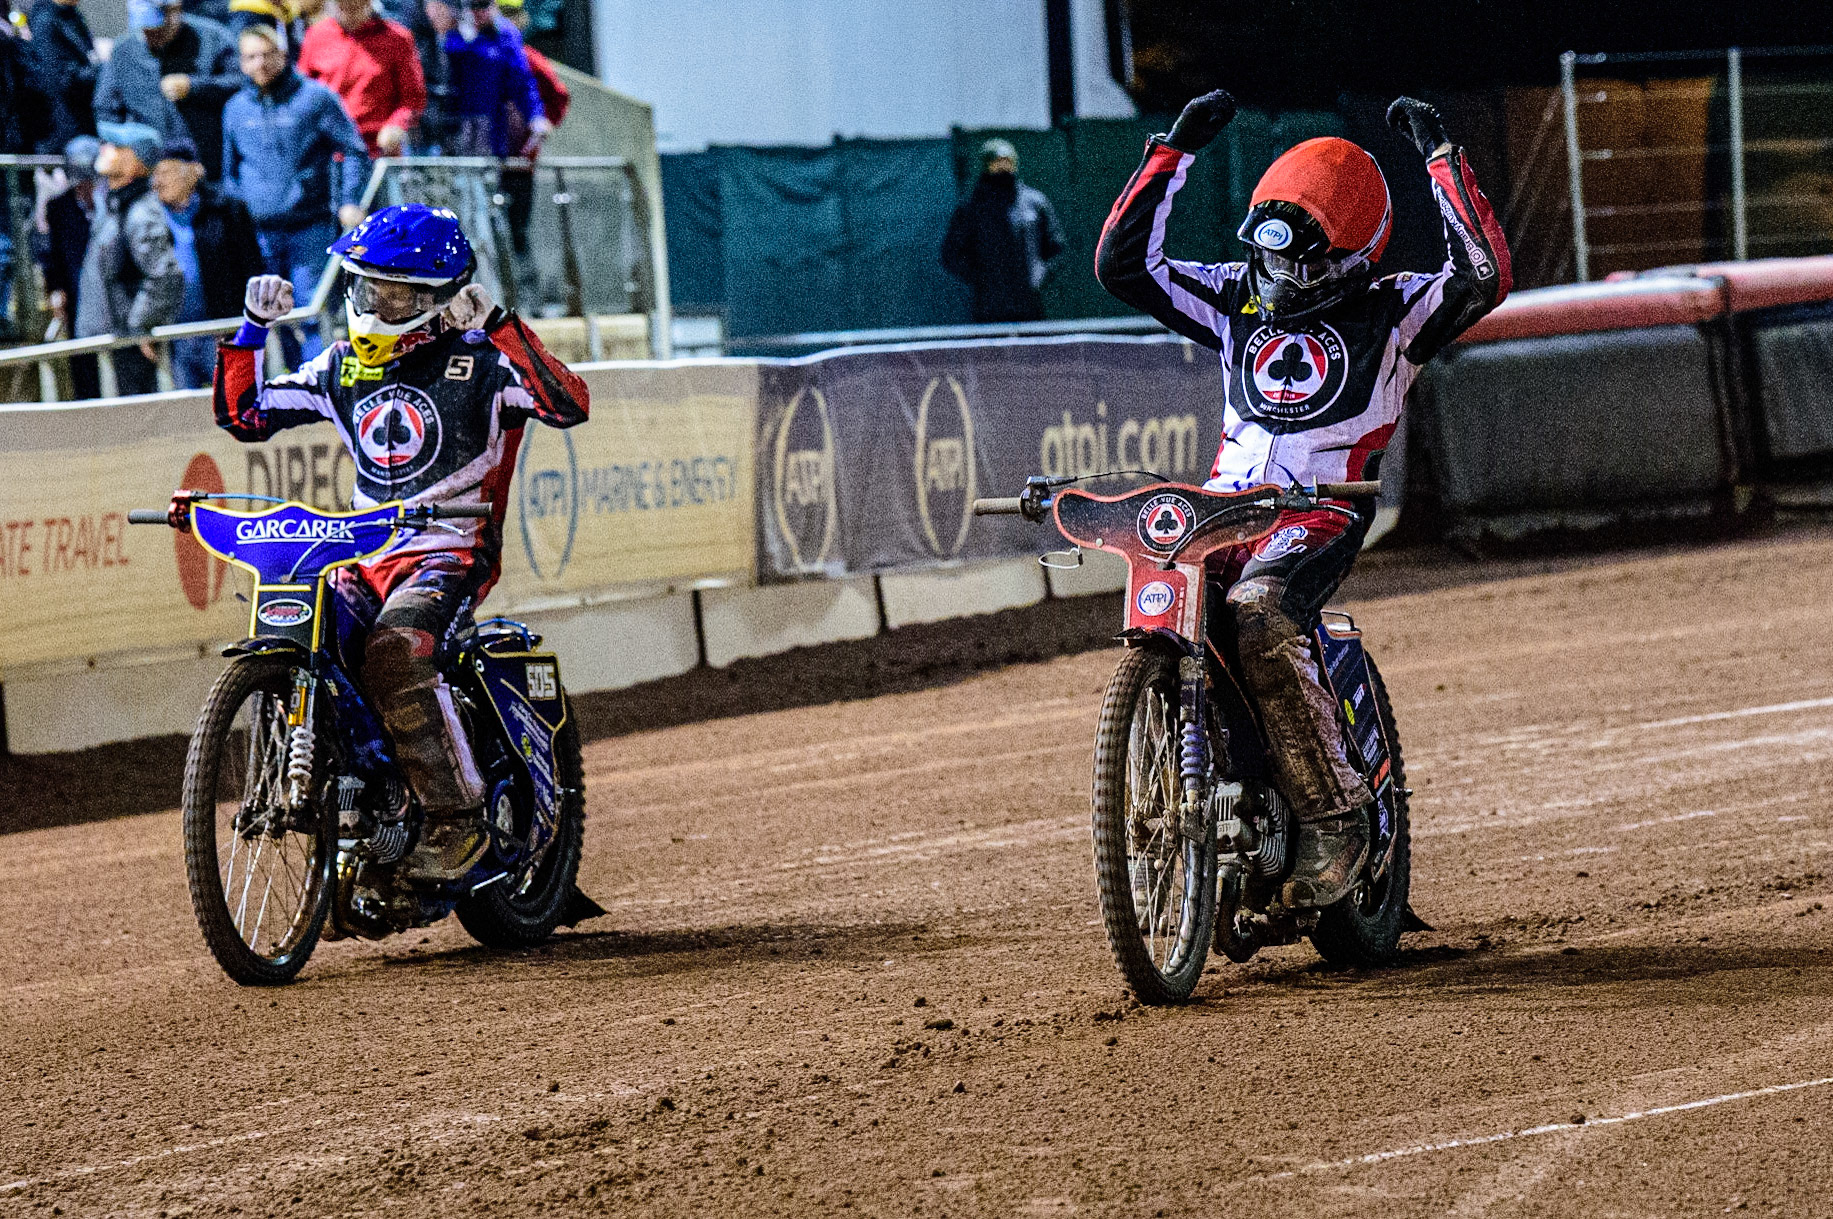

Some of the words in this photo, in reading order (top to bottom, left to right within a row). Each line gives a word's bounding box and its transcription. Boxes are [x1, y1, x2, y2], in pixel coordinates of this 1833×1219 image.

[1262, 228, 1283, 241] ATPI
[1317, 331, 1341, 361] ACES
[413, 396, 435, 425] ACES
[1178, 501, 1192, 518] ACES
[236, 519, 355, 540] GARCAREK
[1143, 592, 1167, 604] ATPI
